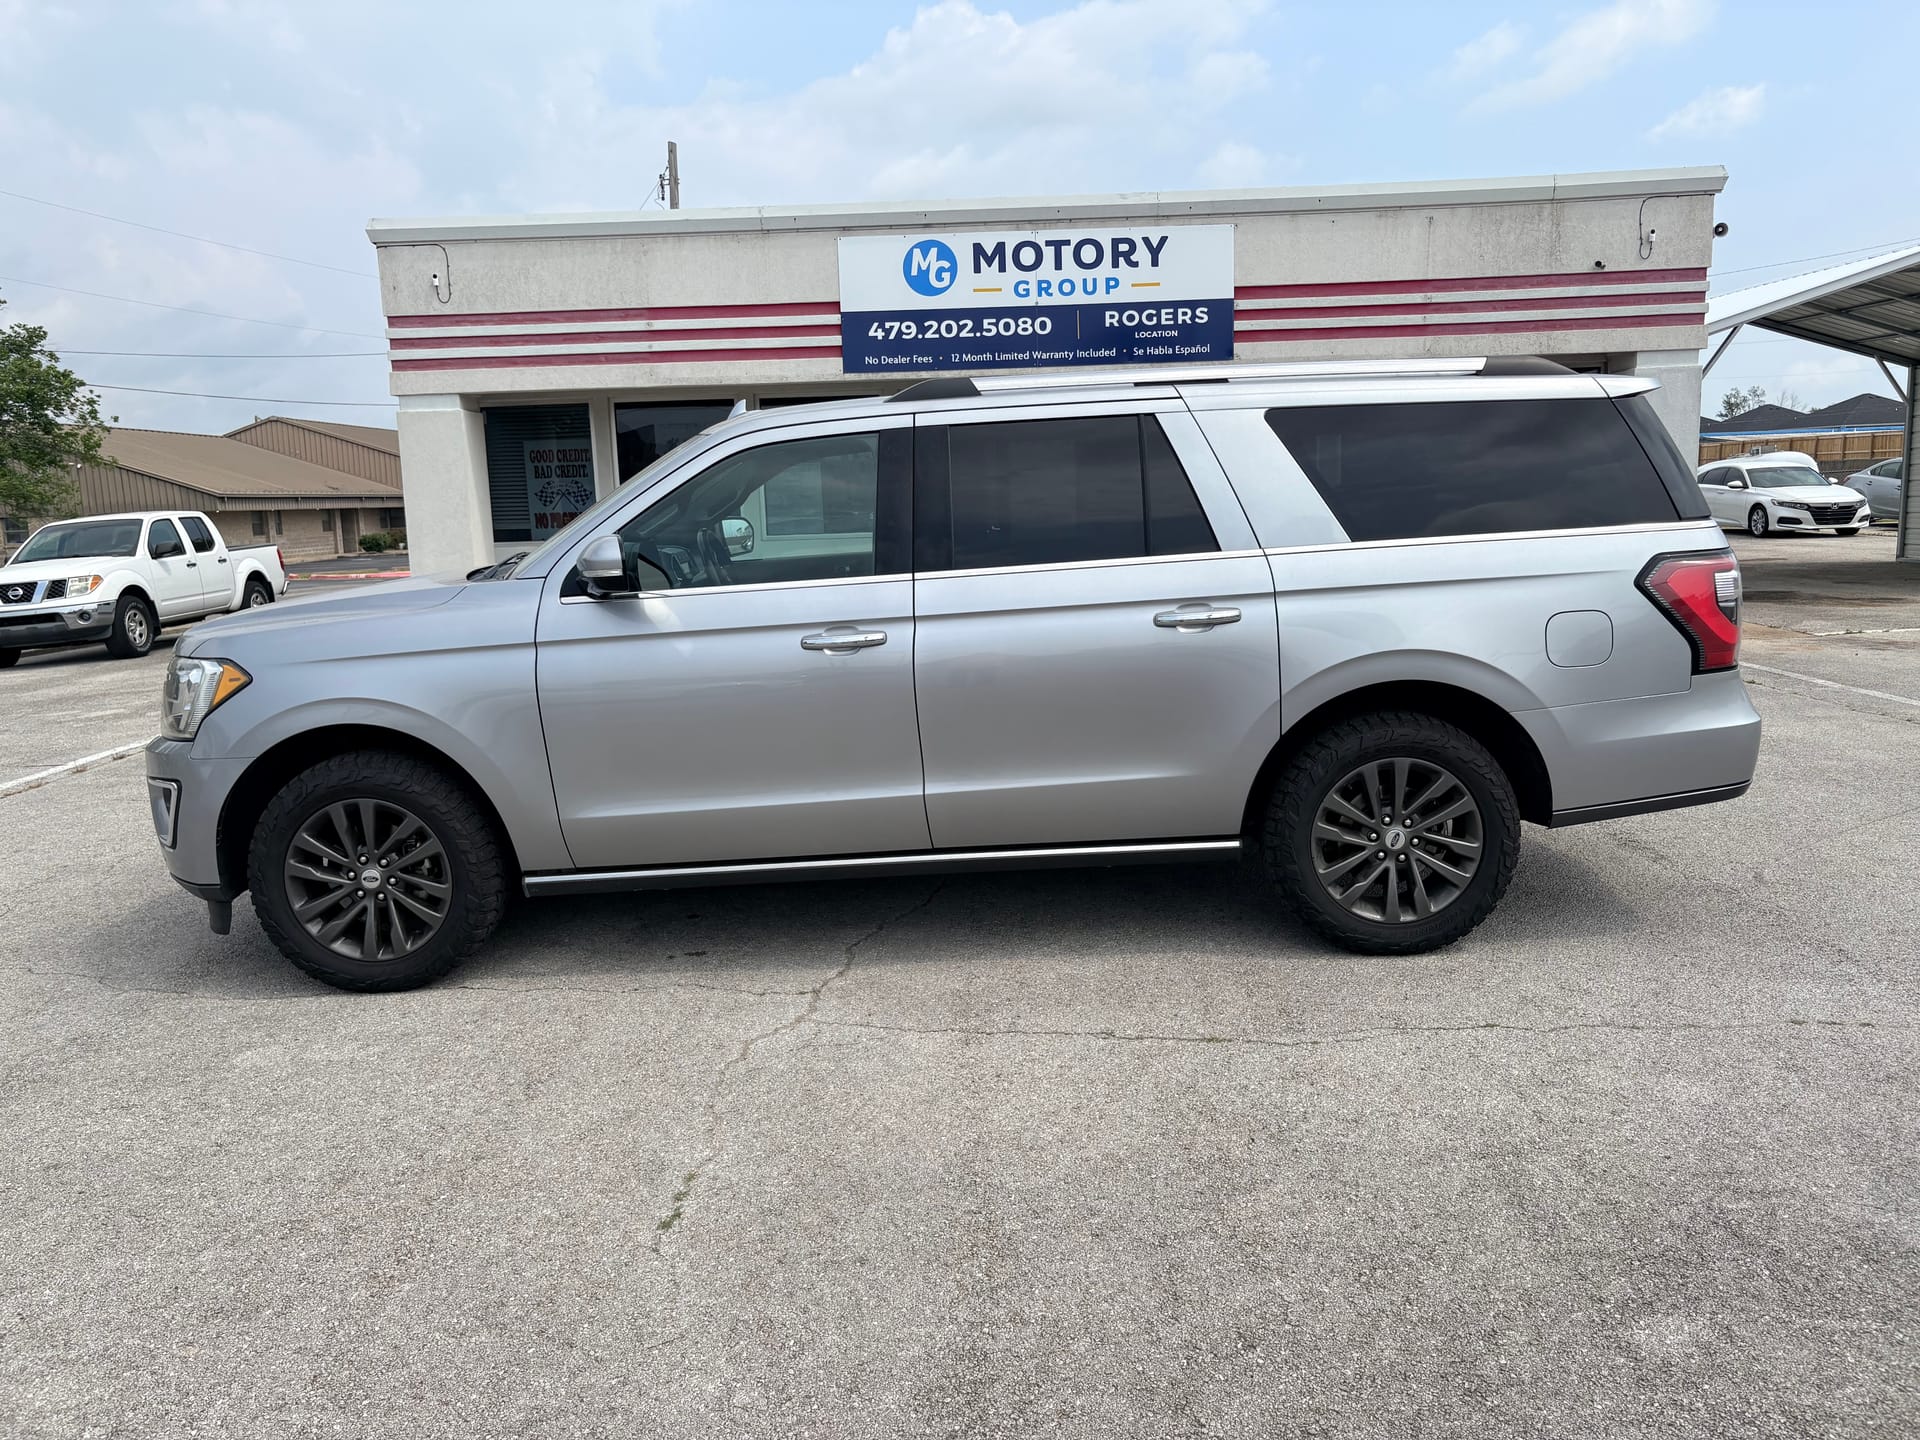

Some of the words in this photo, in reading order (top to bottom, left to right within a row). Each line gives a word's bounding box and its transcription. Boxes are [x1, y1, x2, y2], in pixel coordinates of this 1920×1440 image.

[972, 236, 1169, 274] MOTORY
[911, 247, 951, 288] MG
[1013, 277, 1120, 298] GROUP
[1105, 307, 1209, 327] ROGERS
[868, 317, 1052, 340] 479.202.5080
[1135, 330, 1178, 338] LOCATION
[951, 354, 960, 362] 12
[962, 353, 993, 362] Month
[995, 351, 1030, 361] Limited
[1032, 350, 1074, 360] Warranty
[1076, 348, 1116, 358] Included
[1133, 347, 1144, 355] Se
[1147, 346, 1173, 355] Habla
[1175, 344, 1210, 355] Español
[865, 356, 879, 365] No
[881, 355, 911, 364] Dealer
[913, 355, 933, 364] Fees
[529, 450, 554, 463] GOOD
[534, 465, 553, 479] BAD
[534, 512, 549, 529] NO
